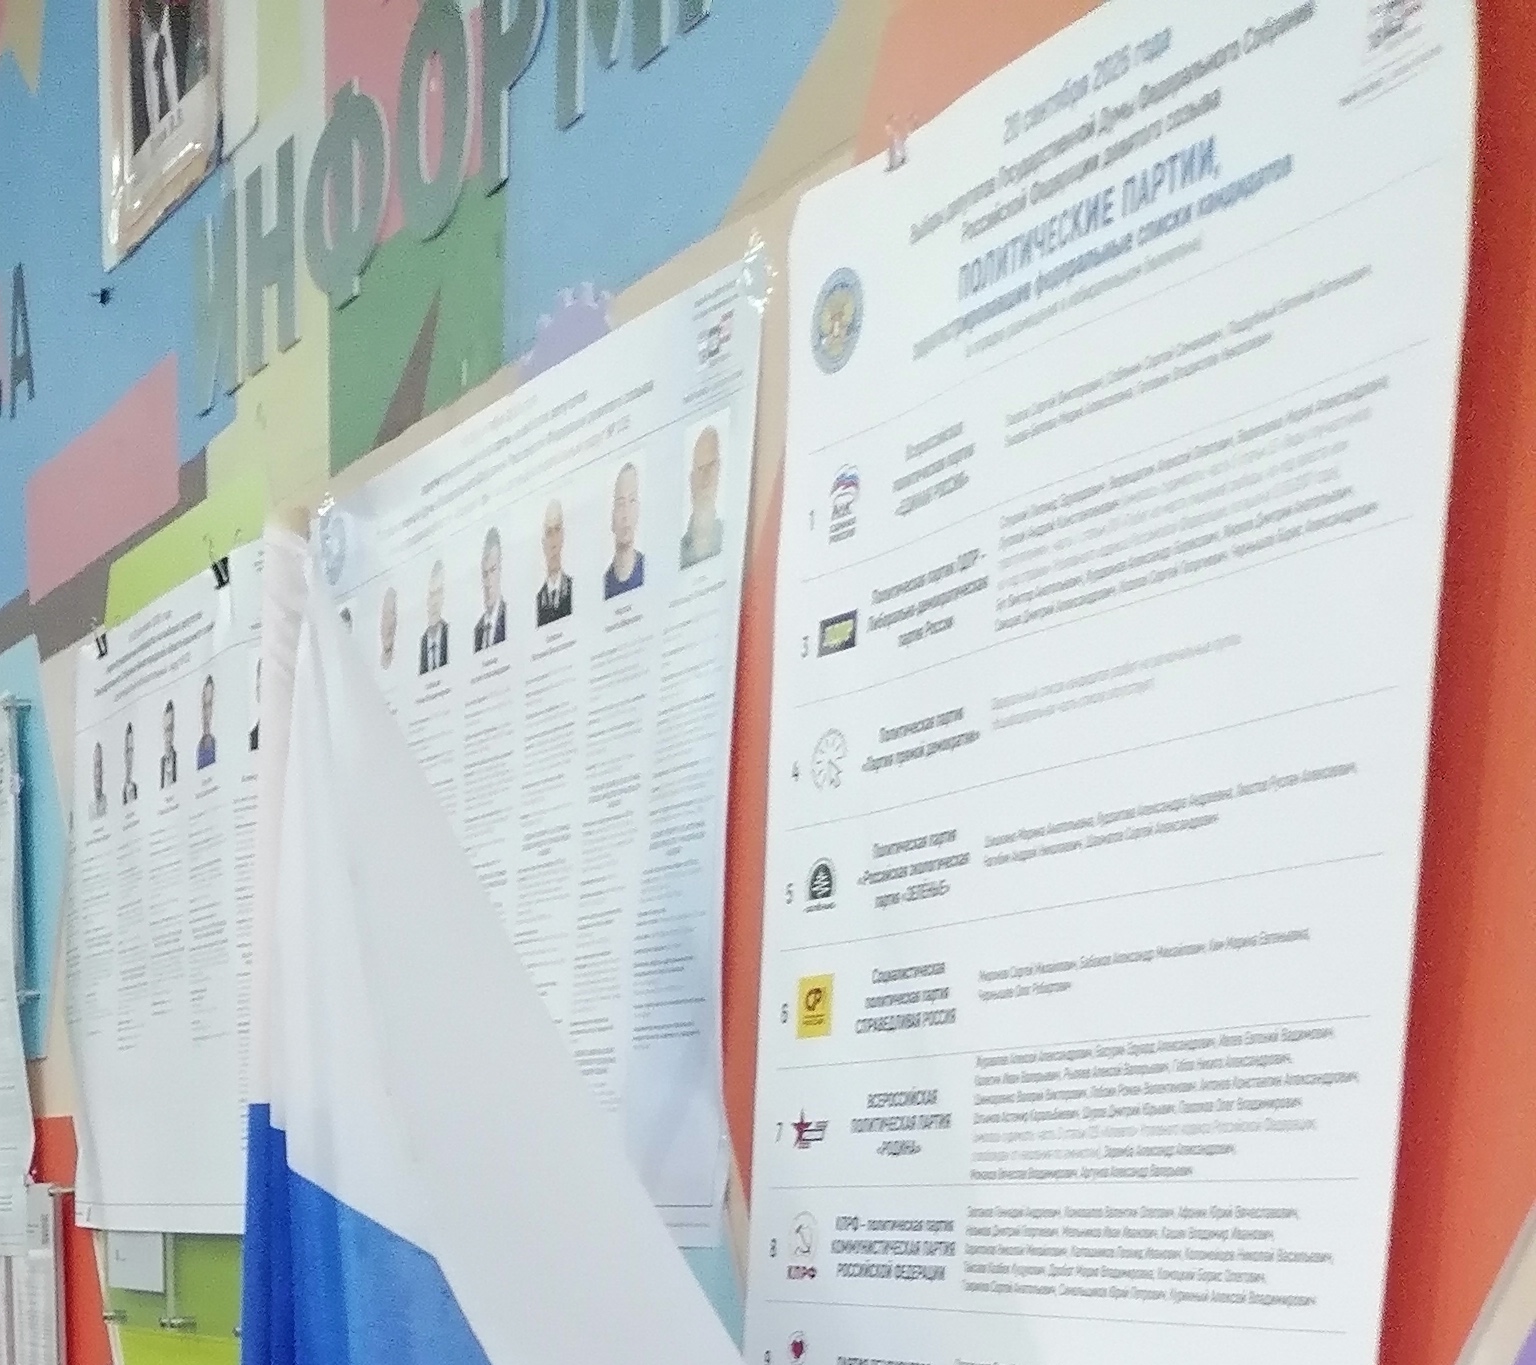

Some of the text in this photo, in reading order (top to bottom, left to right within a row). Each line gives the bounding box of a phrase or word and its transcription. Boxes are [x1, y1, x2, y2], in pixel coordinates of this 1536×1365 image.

[193, 0, 710, 419] ИНФОРМ
[958, 186, 1115, 302] ПОЛИТИЧЕСКИЕ
[1121, 134, 1221, 217] ПАРТИИ,
